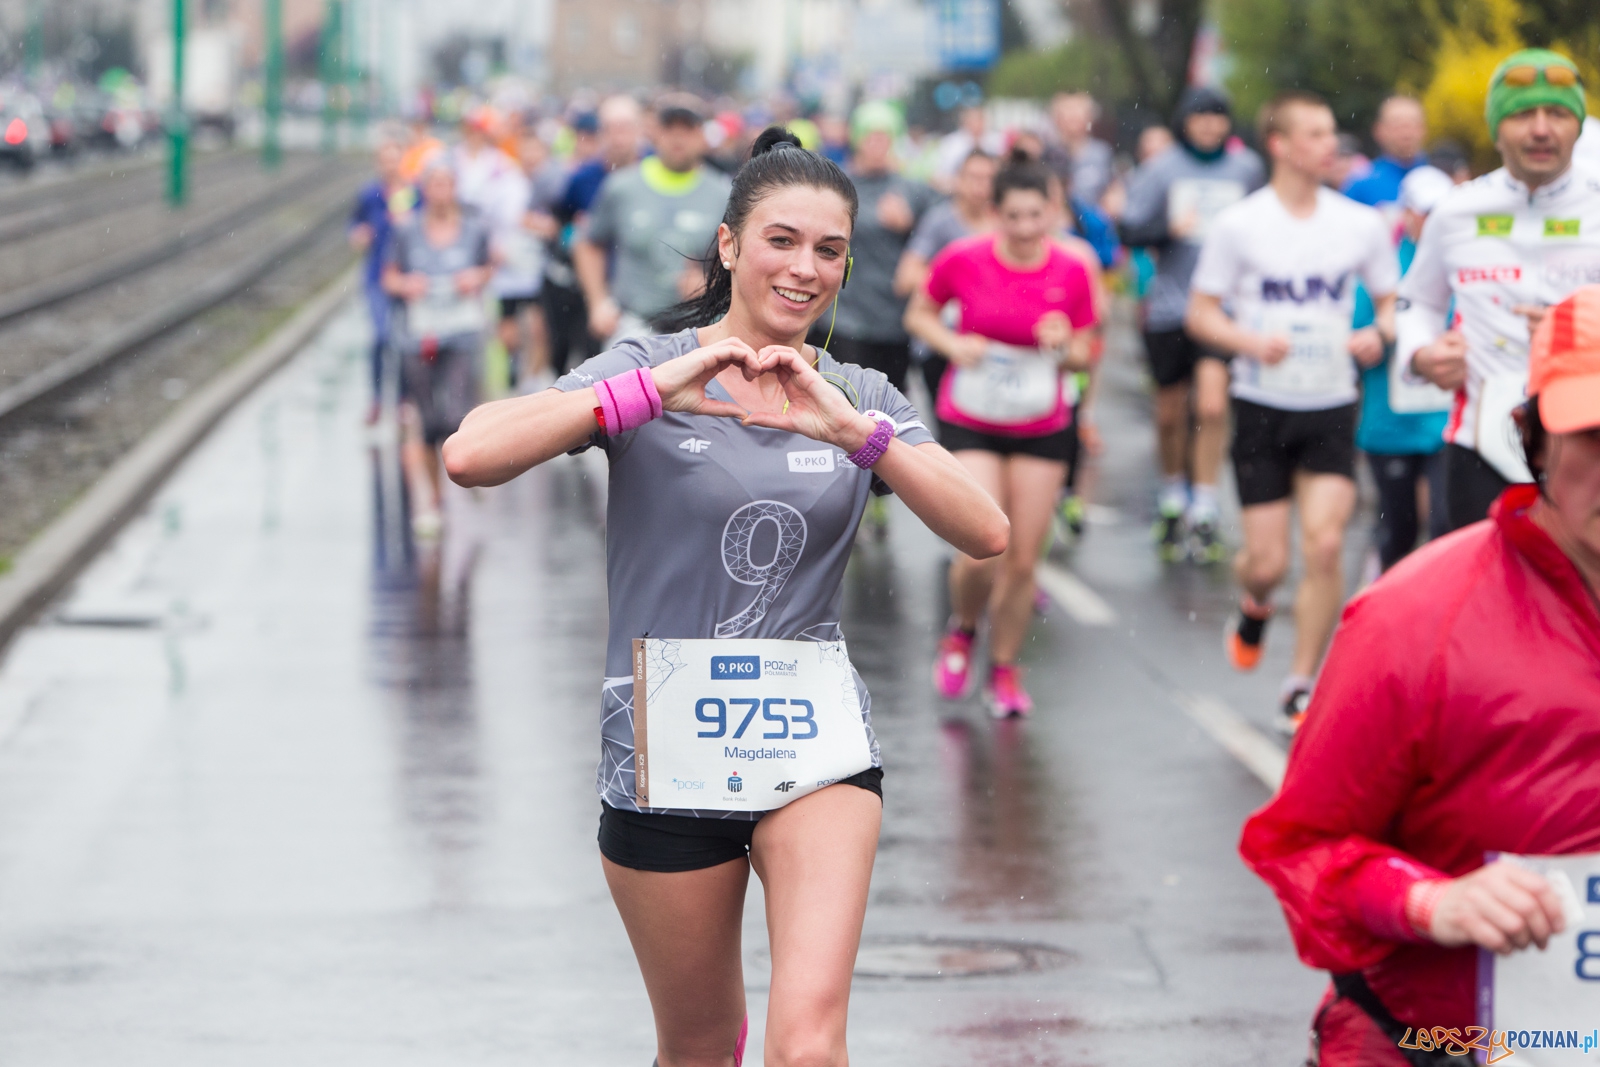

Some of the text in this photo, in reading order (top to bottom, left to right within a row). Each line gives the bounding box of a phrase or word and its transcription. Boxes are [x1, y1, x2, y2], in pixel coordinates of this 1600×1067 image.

[714, 500, 808, 639] 9
[729, 662, 754, 674] PKO
[694, 697, 819, 740] 9753
[724, 746, 797, 762] Magdalena
